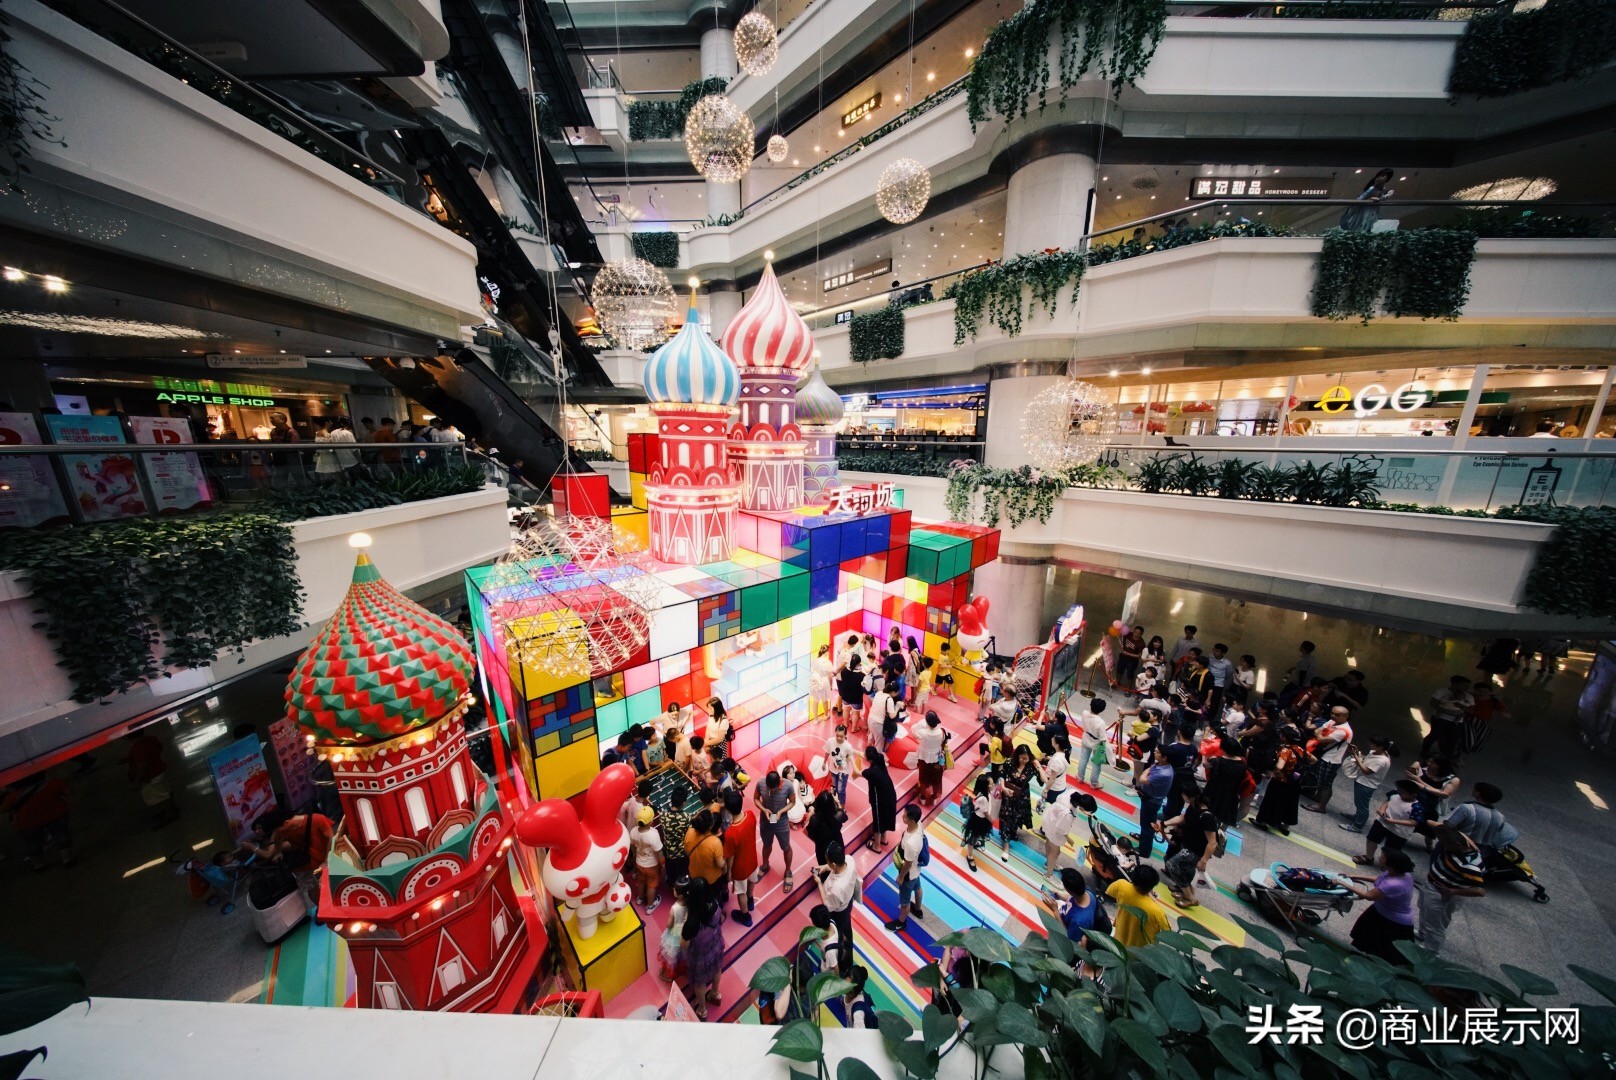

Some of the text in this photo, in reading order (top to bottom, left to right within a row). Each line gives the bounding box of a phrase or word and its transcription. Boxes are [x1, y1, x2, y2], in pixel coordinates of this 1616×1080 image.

[1197, 180, 1262, 195] 满记甜品
[156, 392, 275, 407] APPLE SHOP
[828, 481, 896, 516] 天河城
